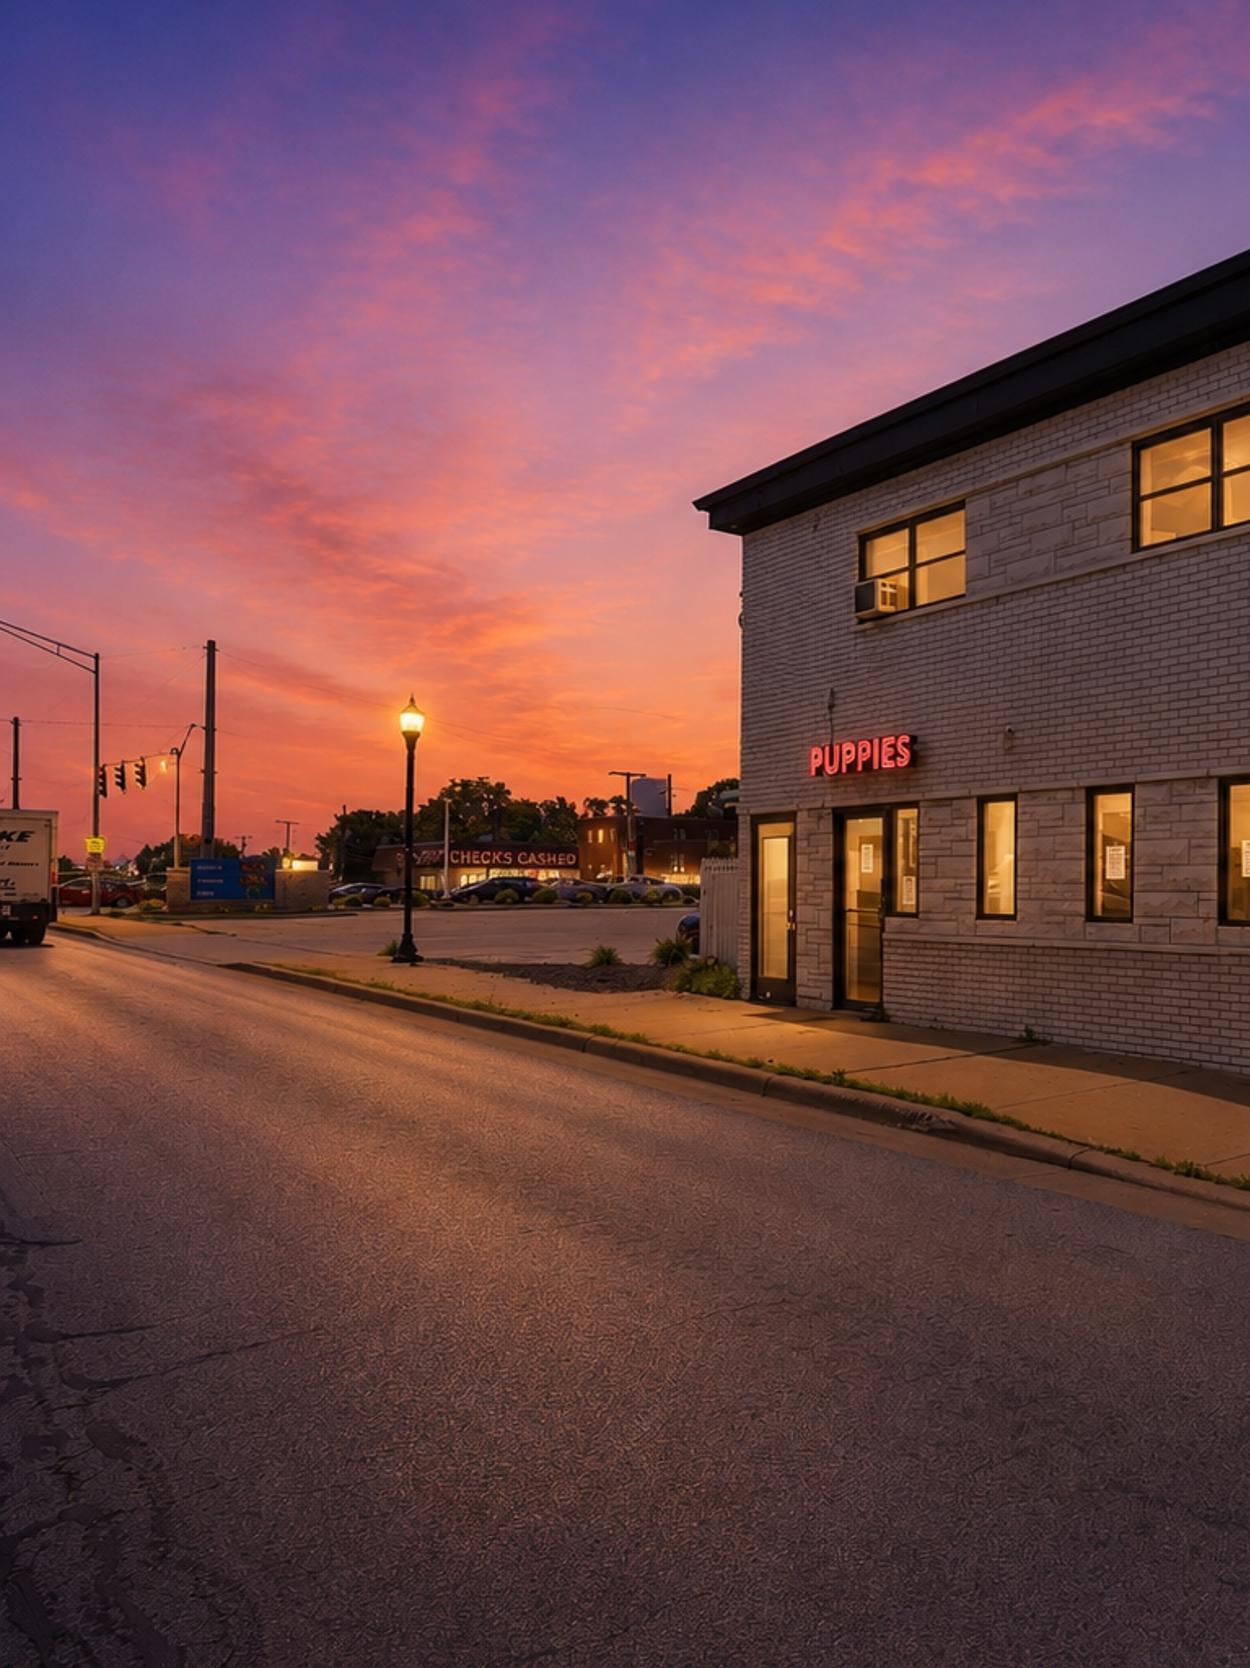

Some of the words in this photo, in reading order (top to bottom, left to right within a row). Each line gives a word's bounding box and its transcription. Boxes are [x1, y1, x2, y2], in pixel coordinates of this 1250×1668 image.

[808, 734, 912, 777] PUPPIES
[450, 850, 513, 865] CHECKS
[517, 852, 577, 866] CASHED
